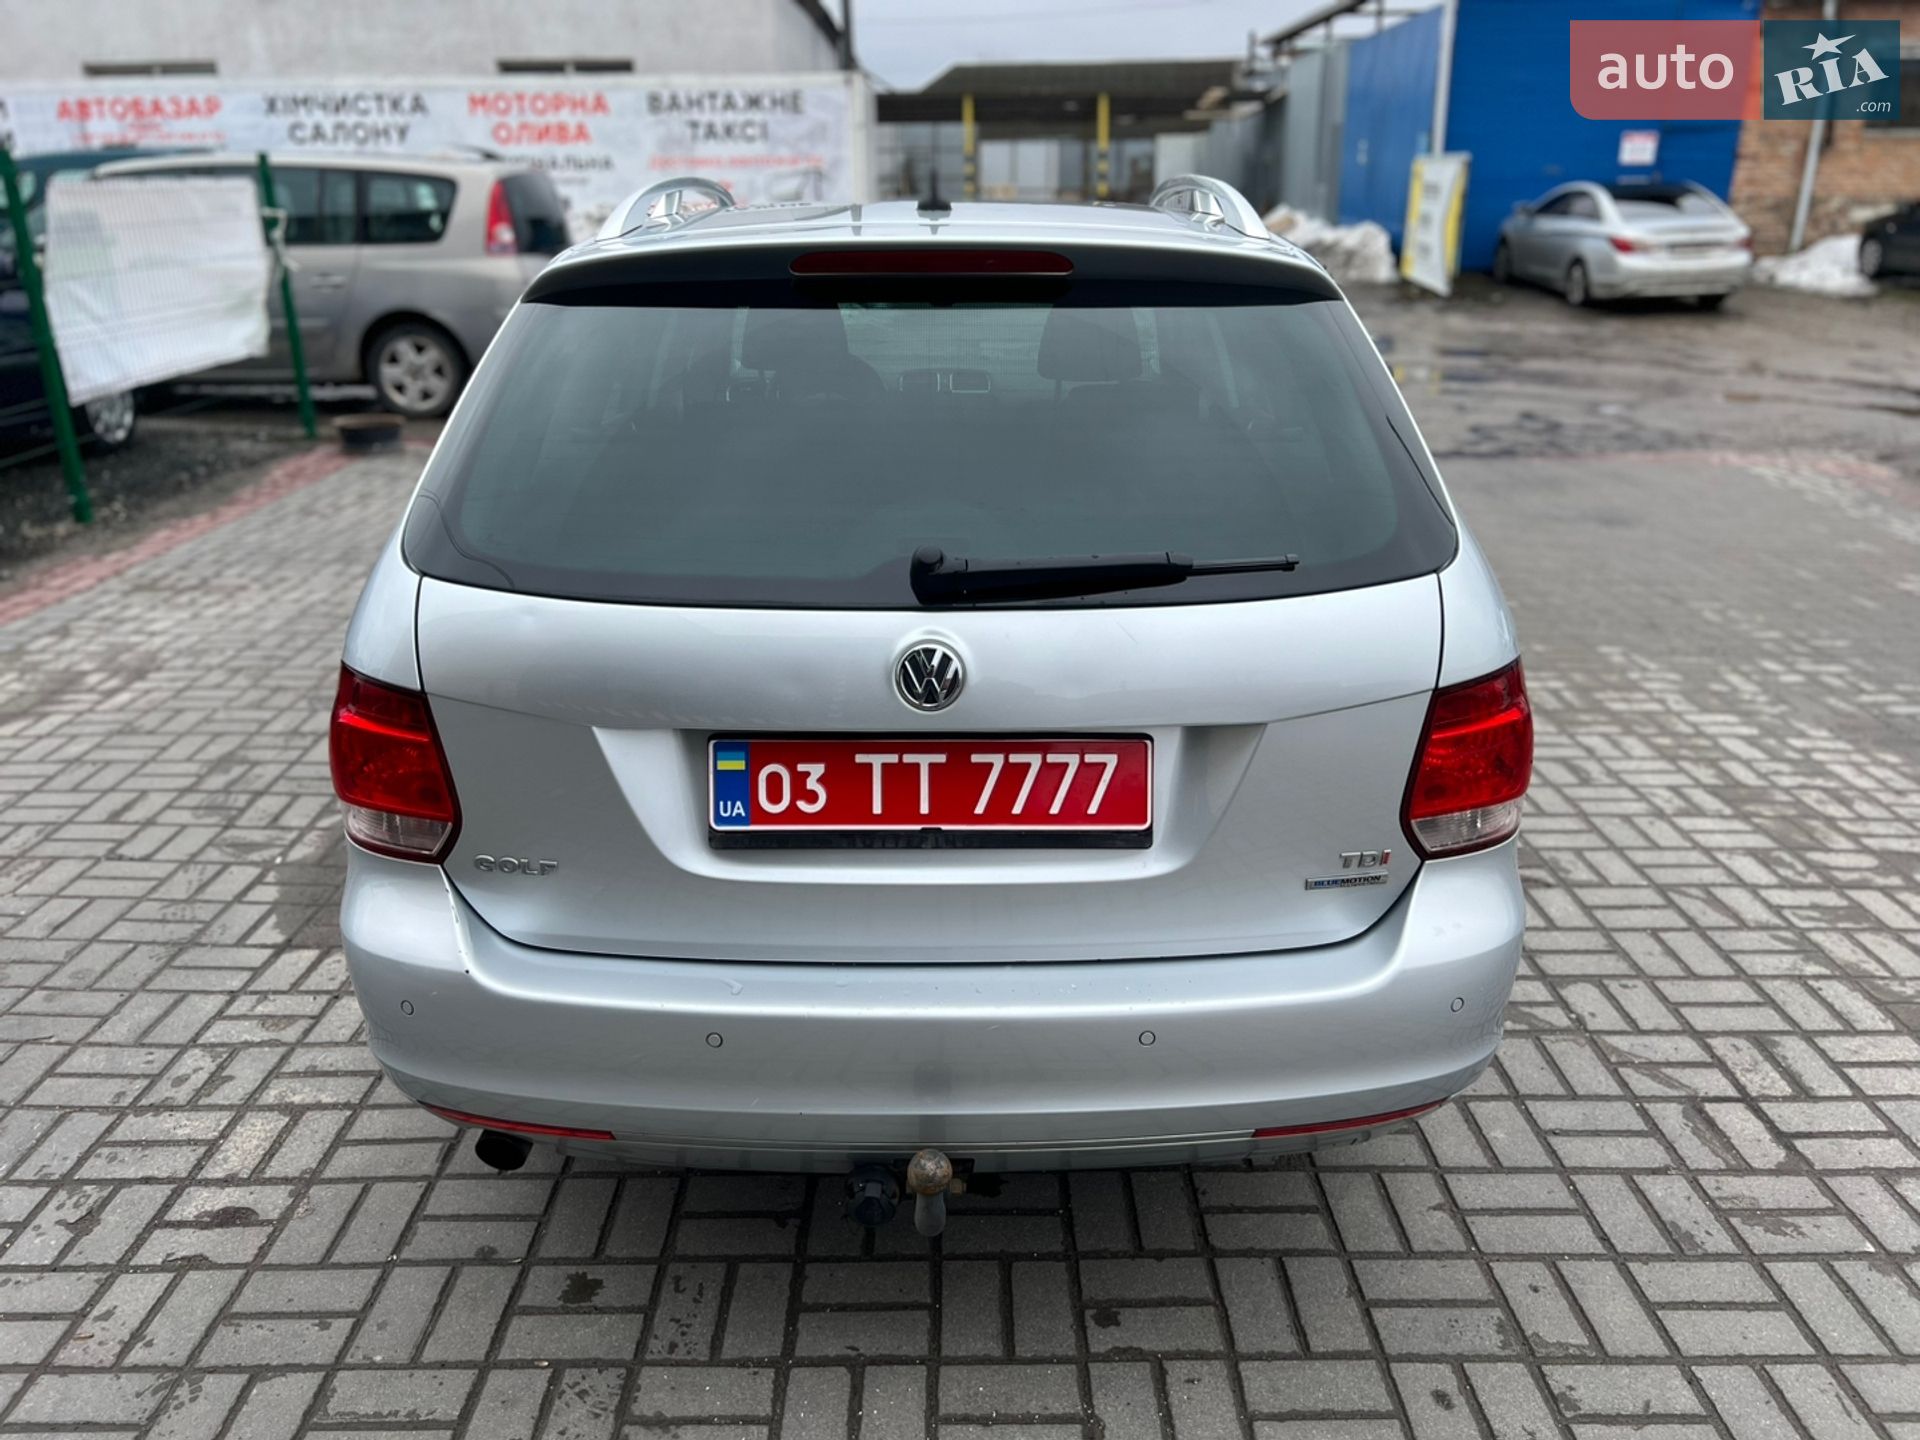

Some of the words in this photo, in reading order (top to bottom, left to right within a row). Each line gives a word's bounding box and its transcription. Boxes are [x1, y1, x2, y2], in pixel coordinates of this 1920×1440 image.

[56, 96, 223, 121] АВТОБАЗАР
[263, 93, 430, 117] ХІМЧИСТКА
[468, 92, 609, 116] МОТОРНА
[647, 91, 803, 115] ВАНТАЖНЕ
[288, 121, 411, 146] САЛОНУ
[492, 121, 591, 146] ОЛИВА
[687, 120, 769, 144] ТАКСІ
[757, 762, 828, 814] 03
[854, 753, 947, 815] TT
[970, 753, 1119, 815] 7777
[718, 801, 746, 817] UA
[474, 854, 559, 876] GOLF
[1340, 849, 1392, 869] TDI
[1313, 875, 1382, 887] BLUEMOTION
